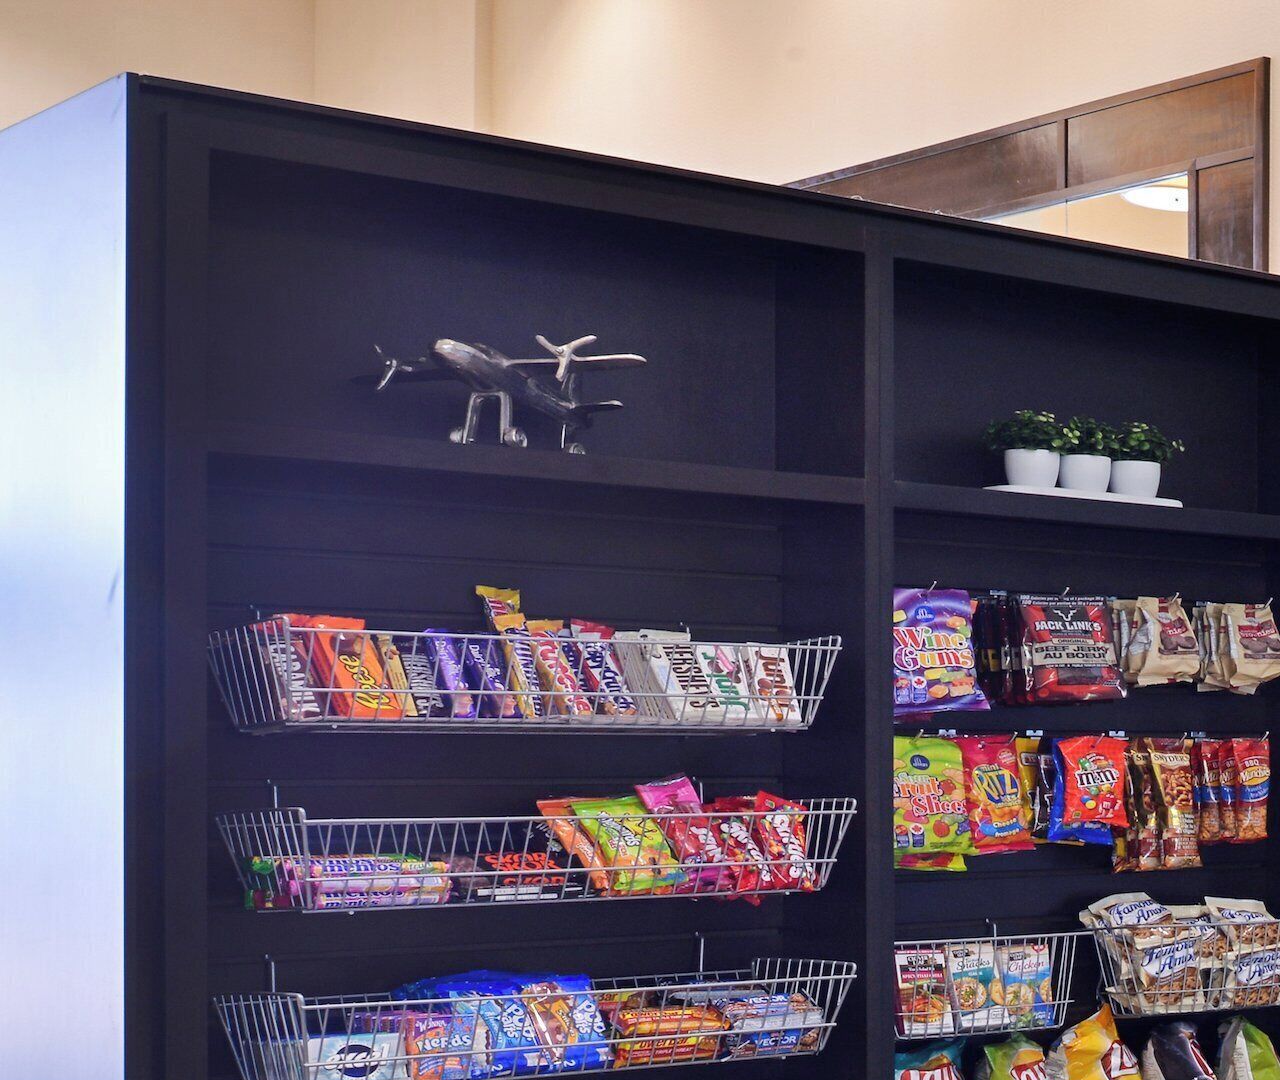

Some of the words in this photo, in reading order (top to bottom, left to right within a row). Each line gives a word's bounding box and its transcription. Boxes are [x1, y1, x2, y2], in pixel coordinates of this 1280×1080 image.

[1035, 621, 1062, 631] JACK
[1064, 620, 1101, 631] LINK'S
[894, 627, 968, 650] Wine
[893, 647, 975, 671] Gums
[974, 770, 1018, 801] RITZ
[1008, 959, 1044, 972] Chicken
[755, 1035, 797, 1045] VECTOR
[323, 1044, 390, 1069] excel
